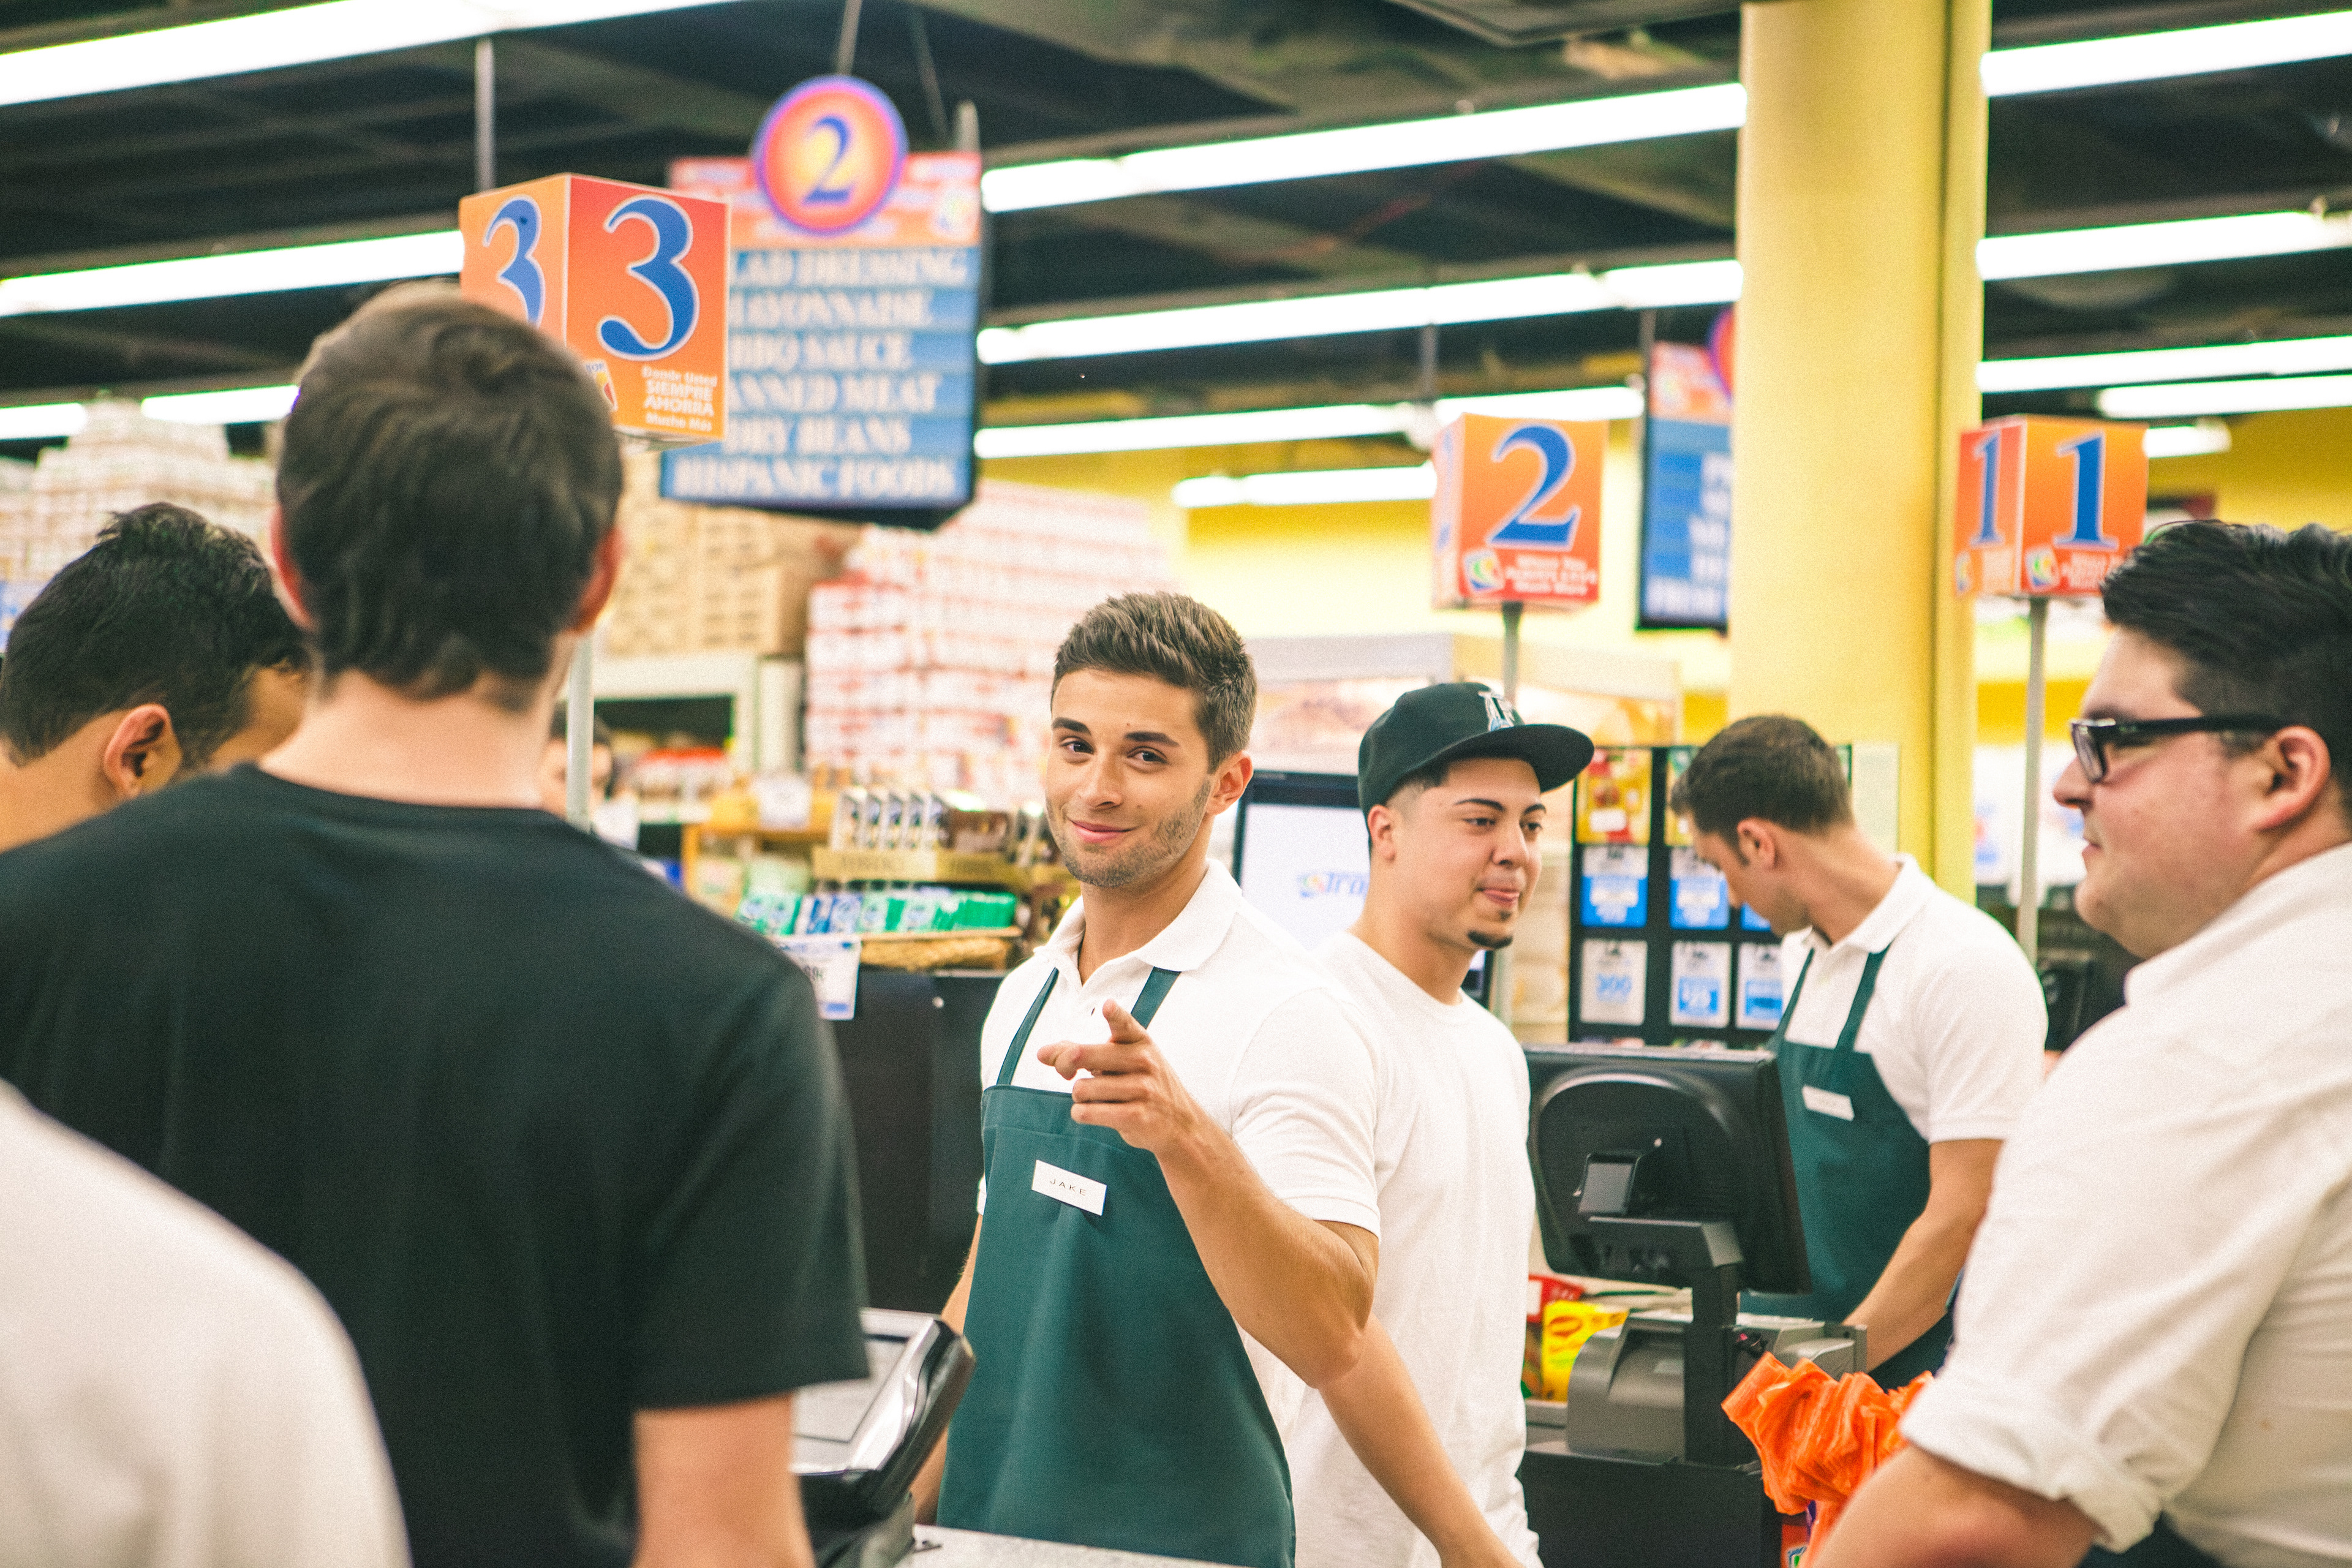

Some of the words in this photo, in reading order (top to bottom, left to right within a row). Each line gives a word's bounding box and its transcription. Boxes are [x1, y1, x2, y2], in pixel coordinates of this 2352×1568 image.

[799, 115, 853, 206] 2
[595, 193, 700, 362] 3
[644, 394, 714, 417] AHORRA
[646, 379, 714, 402] SIEMPRE
[673, 456, 838, 497] HISPANIC
[840, 457, 957, 497] FOODS
[1490, 420, 1582, 551] 2
[1969, 428, 2005, 548] 1
[2052, 428, 2119, 549] 1
[1050, 1178, 1087, 1197] JAKE
